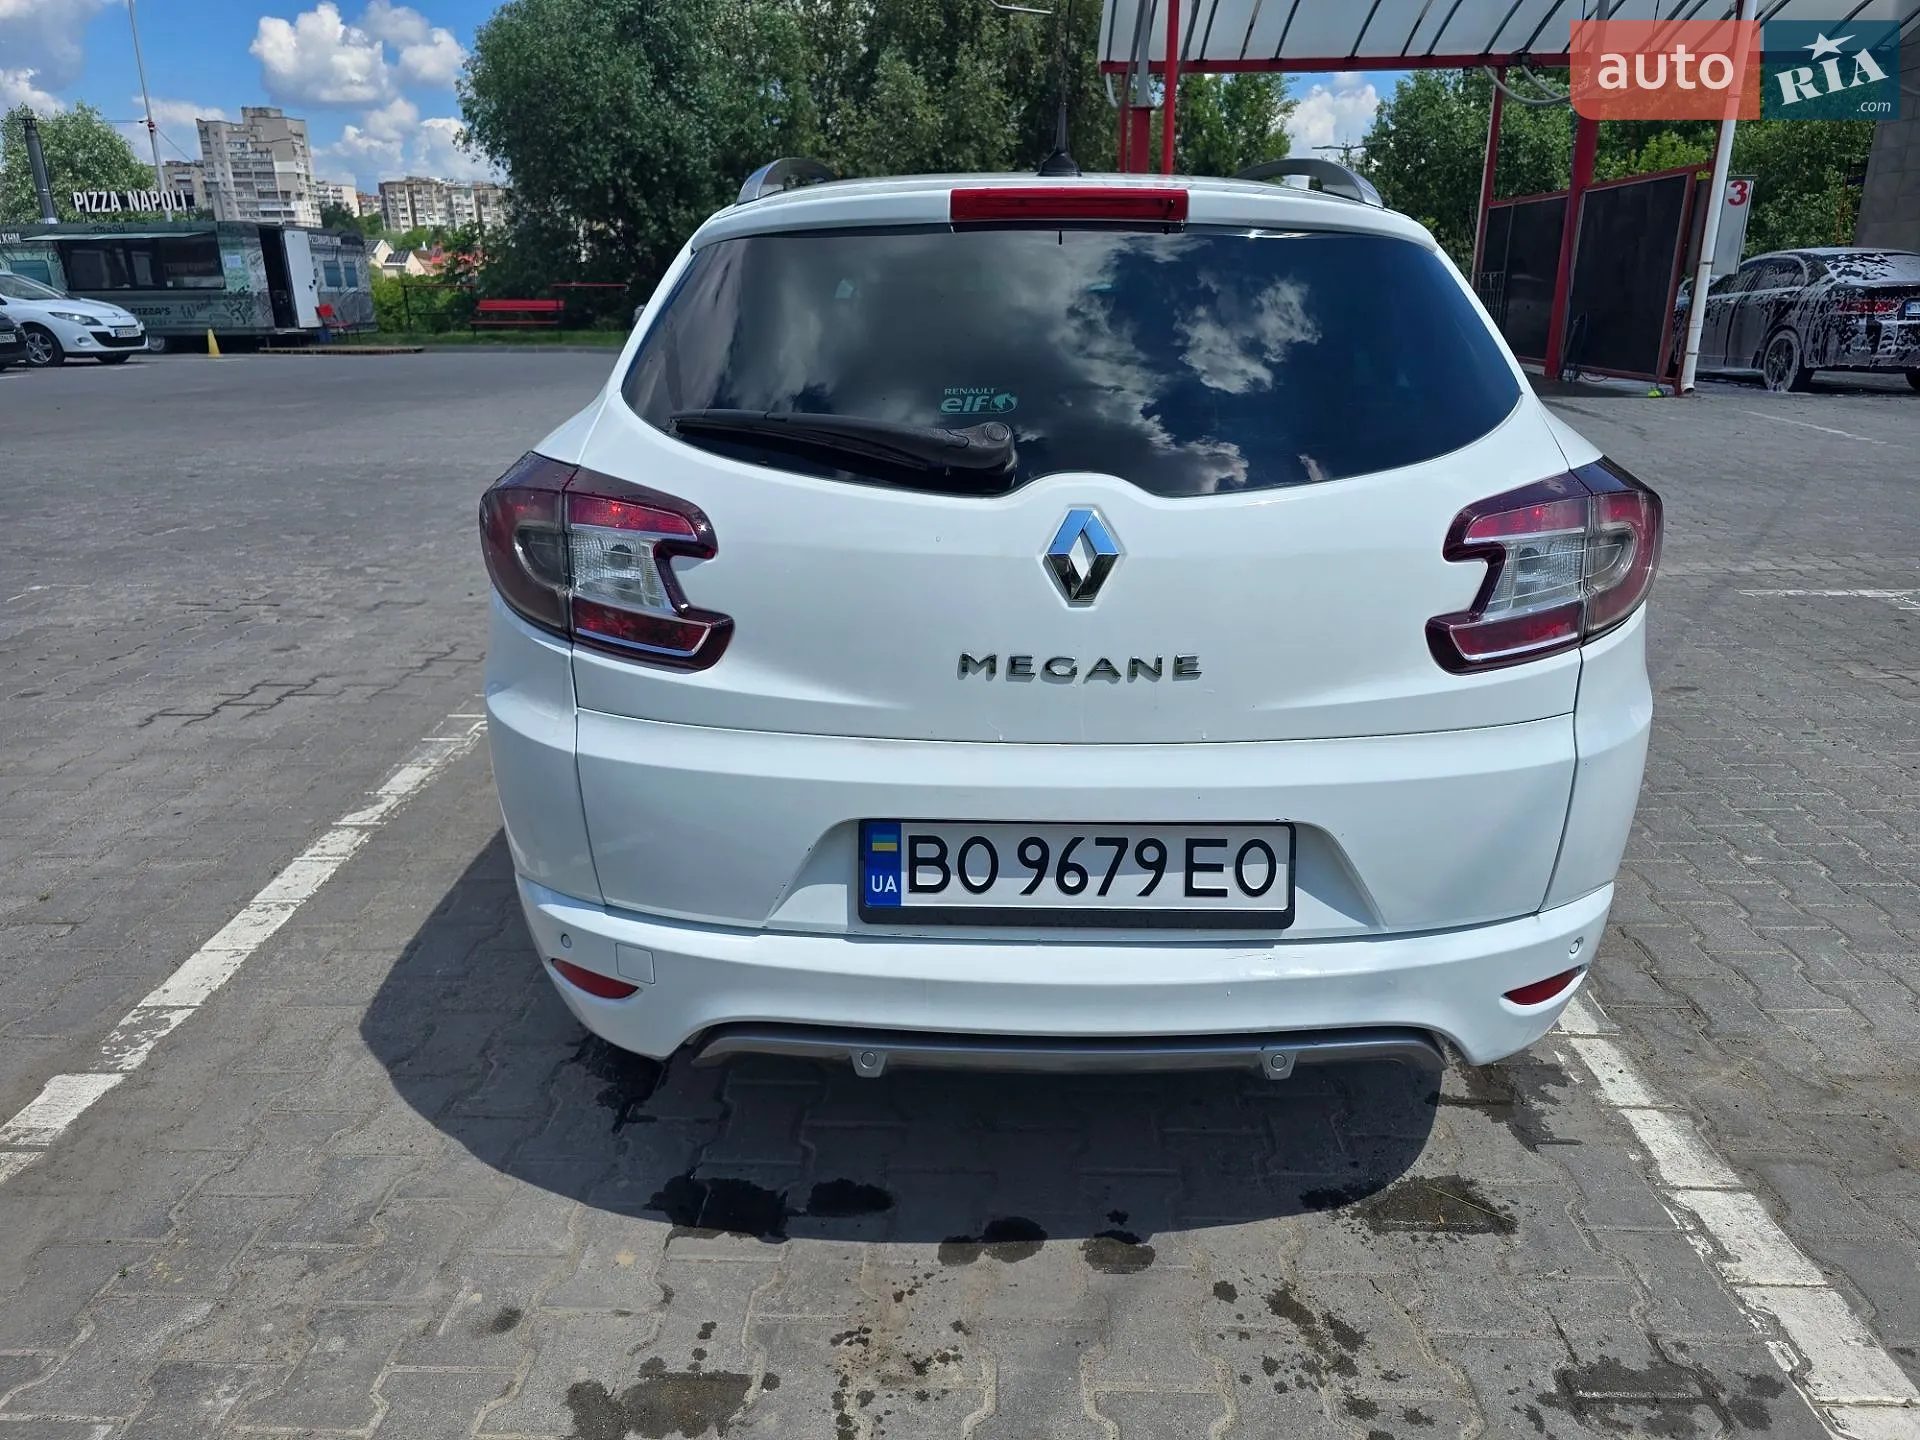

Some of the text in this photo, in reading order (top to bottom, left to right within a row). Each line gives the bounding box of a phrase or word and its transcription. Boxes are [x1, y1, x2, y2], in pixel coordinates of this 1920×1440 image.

[73, 189, 188, 213] PIZZA NAPOLI
[1727, 180, 1748, 207] 3
[944, 387, 996, 395] RENAULT
[941, 396, 990, 413] elf
[959, 652, 1202, 681] MEGANE
[907, 834, 1278, 898] BO 9679 EO
[871, 874, 898, 893] UA
